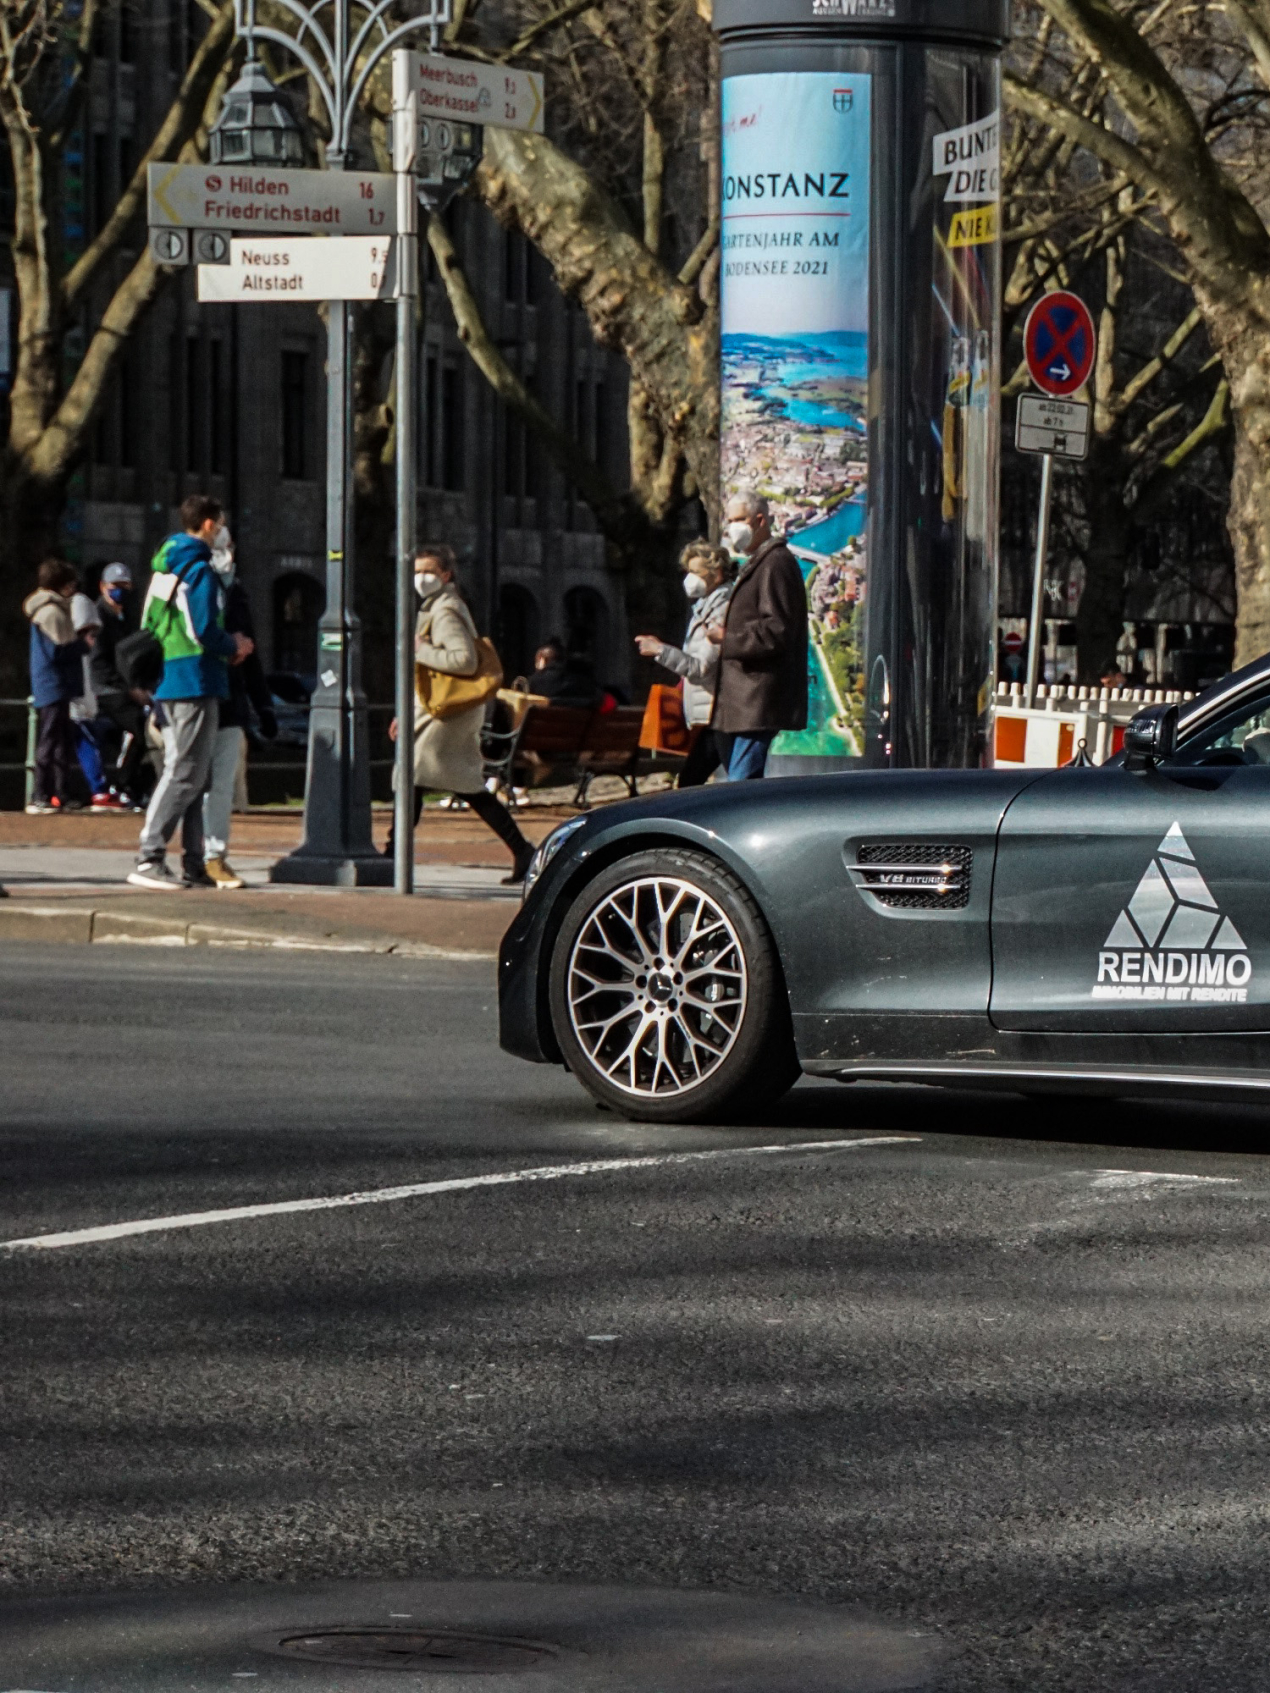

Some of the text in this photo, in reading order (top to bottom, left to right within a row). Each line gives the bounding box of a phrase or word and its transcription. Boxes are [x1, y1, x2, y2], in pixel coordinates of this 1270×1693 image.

[419, 63, 478, 87] Meerbusch
[230, 175, 289, 196] Hilden
[359, 182, 374, 199] 16
[955, 169, 987, 194] DIE
[204, 200, 341, 223] Friedrichstadt
[955, 217, 982, 240] NIE
[809, 232, 840, 247] AM
[241, 250, 290, 266] Neuss
[793, 260, 829, 275] 2021
[242, 274, 304, 291] Altstadt
[880, 873, 947, 884] V8 BITURBO
[1097, 951, 1252, 986] RENDIMO
[1091, 985, 1248, 1003] IMMOBILIEN MIT RENDITE
